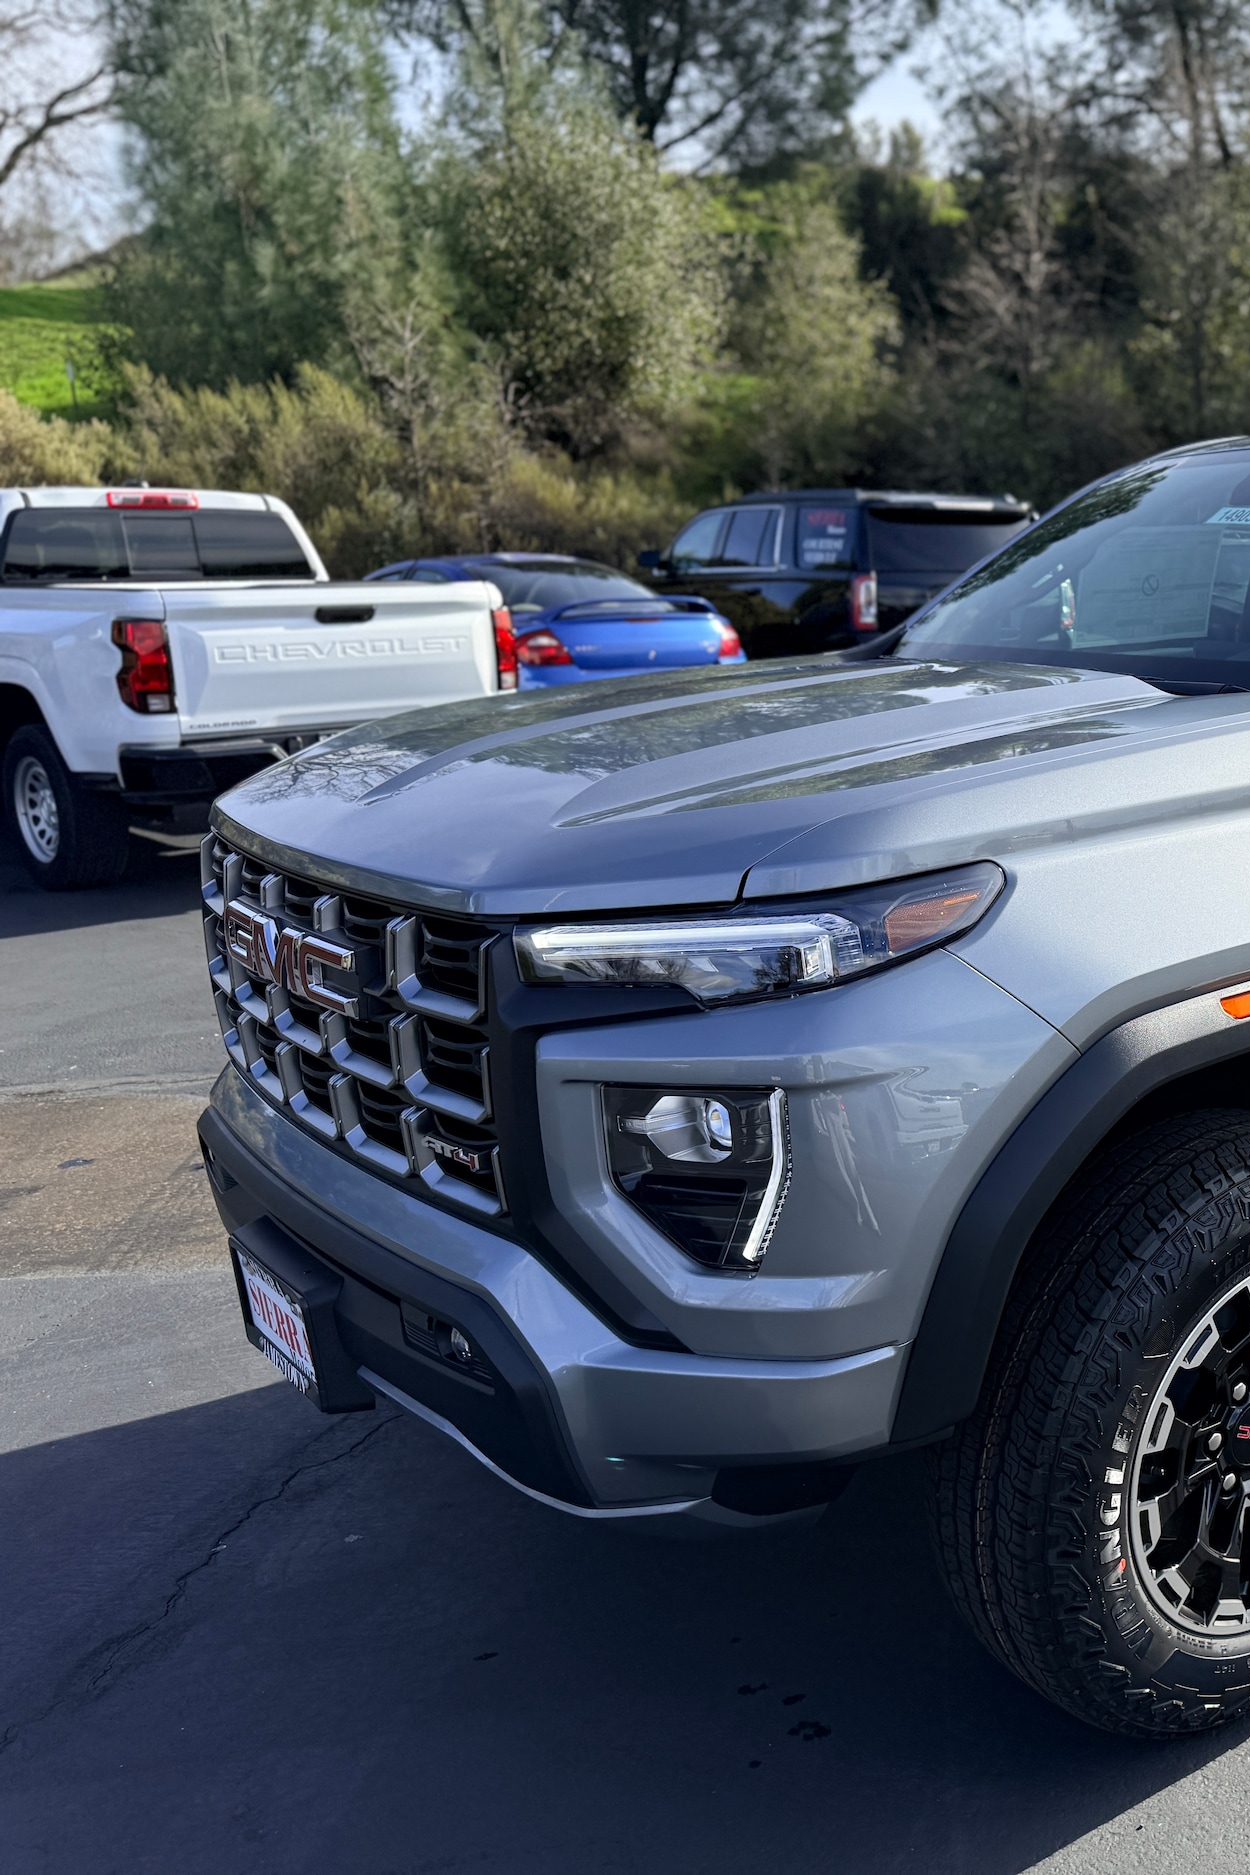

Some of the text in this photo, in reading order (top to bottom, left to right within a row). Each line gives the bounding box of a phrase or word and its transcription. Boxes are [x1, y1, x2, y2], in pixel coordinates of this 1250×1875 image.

[214, 634, 469, 665] CHEVROLET
[190, 718, 257, 731] COLORADO
[224, 899, 360, 1019] GMC
[421, 1135, 480, 1173] AT4
[248, 1278, 313, 1362] SIERRA
[1100, 1384, 1155, 1661] WRANGLER
